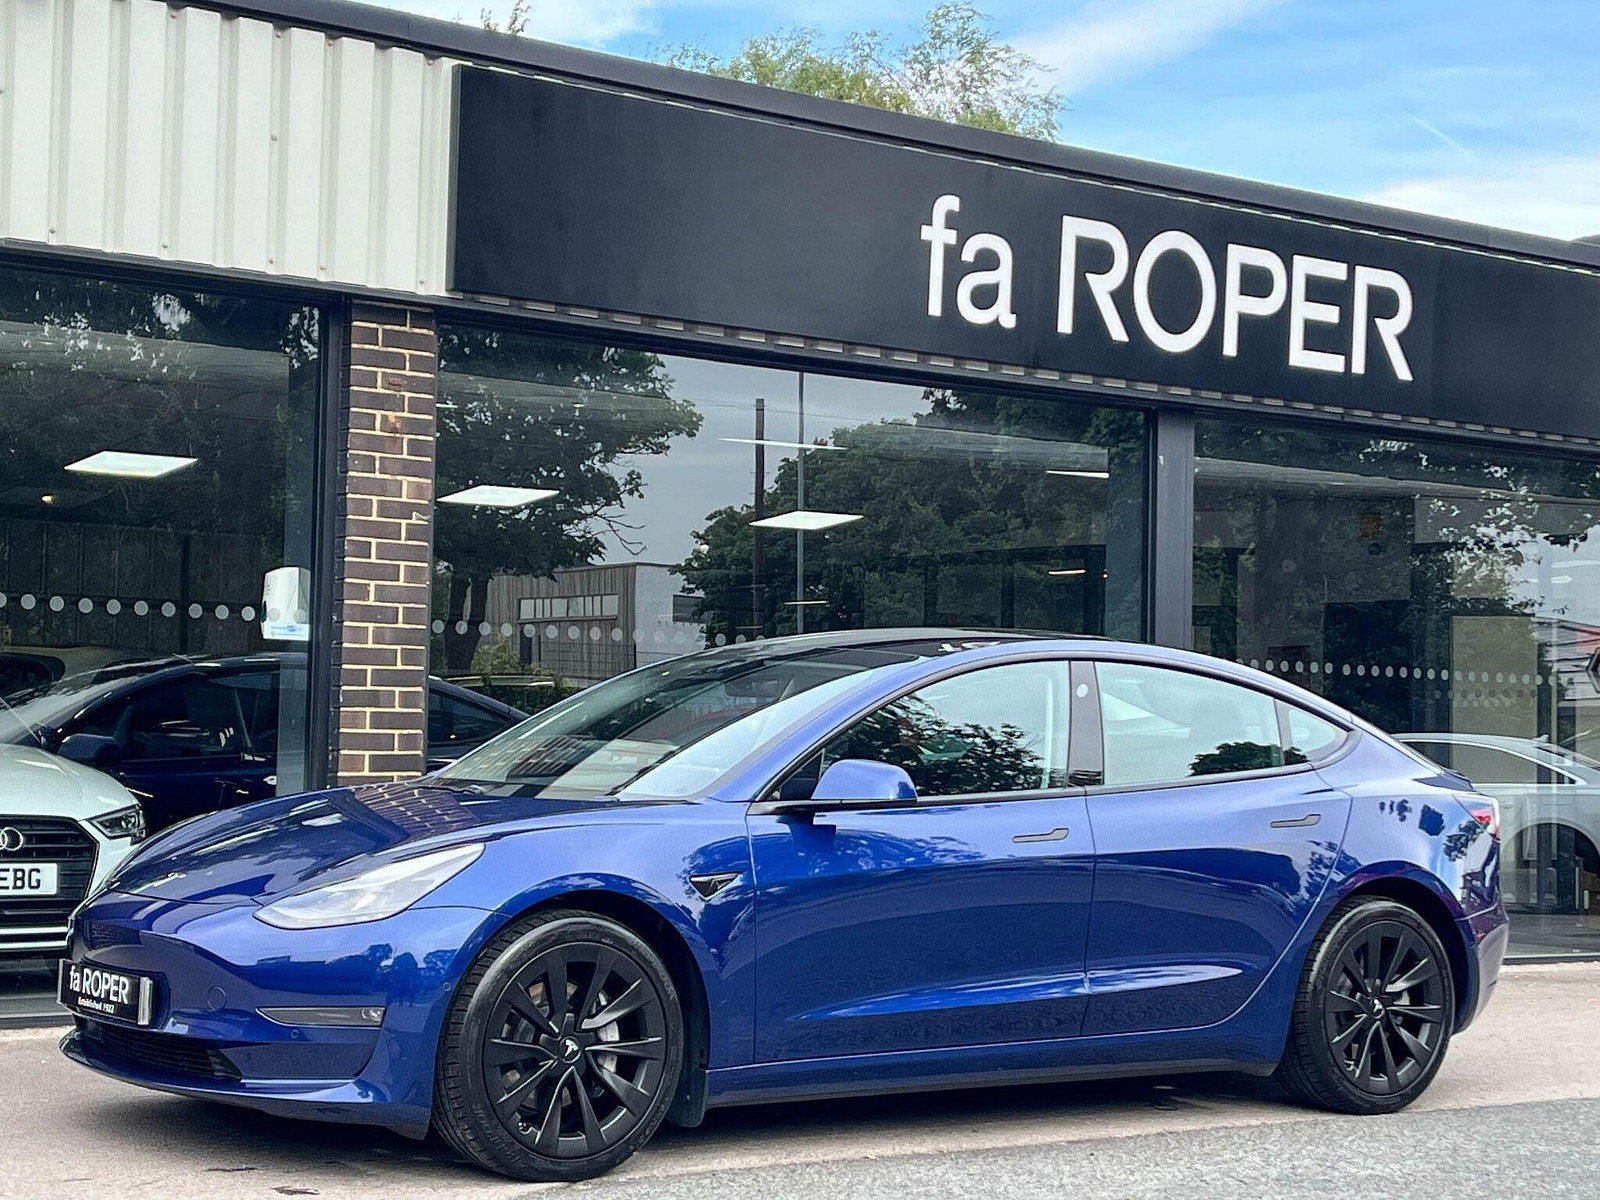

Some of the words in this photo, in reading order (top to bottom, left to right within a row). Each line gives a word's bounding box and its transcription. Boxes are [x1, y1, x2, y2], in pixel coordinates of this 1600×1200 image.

[921, 194, 1017, 330] fa
[1057, 214, 1414, 383] ROPER
[69, 965, 81, 993] fa
[82, 968, 130, 1005] ROPER
